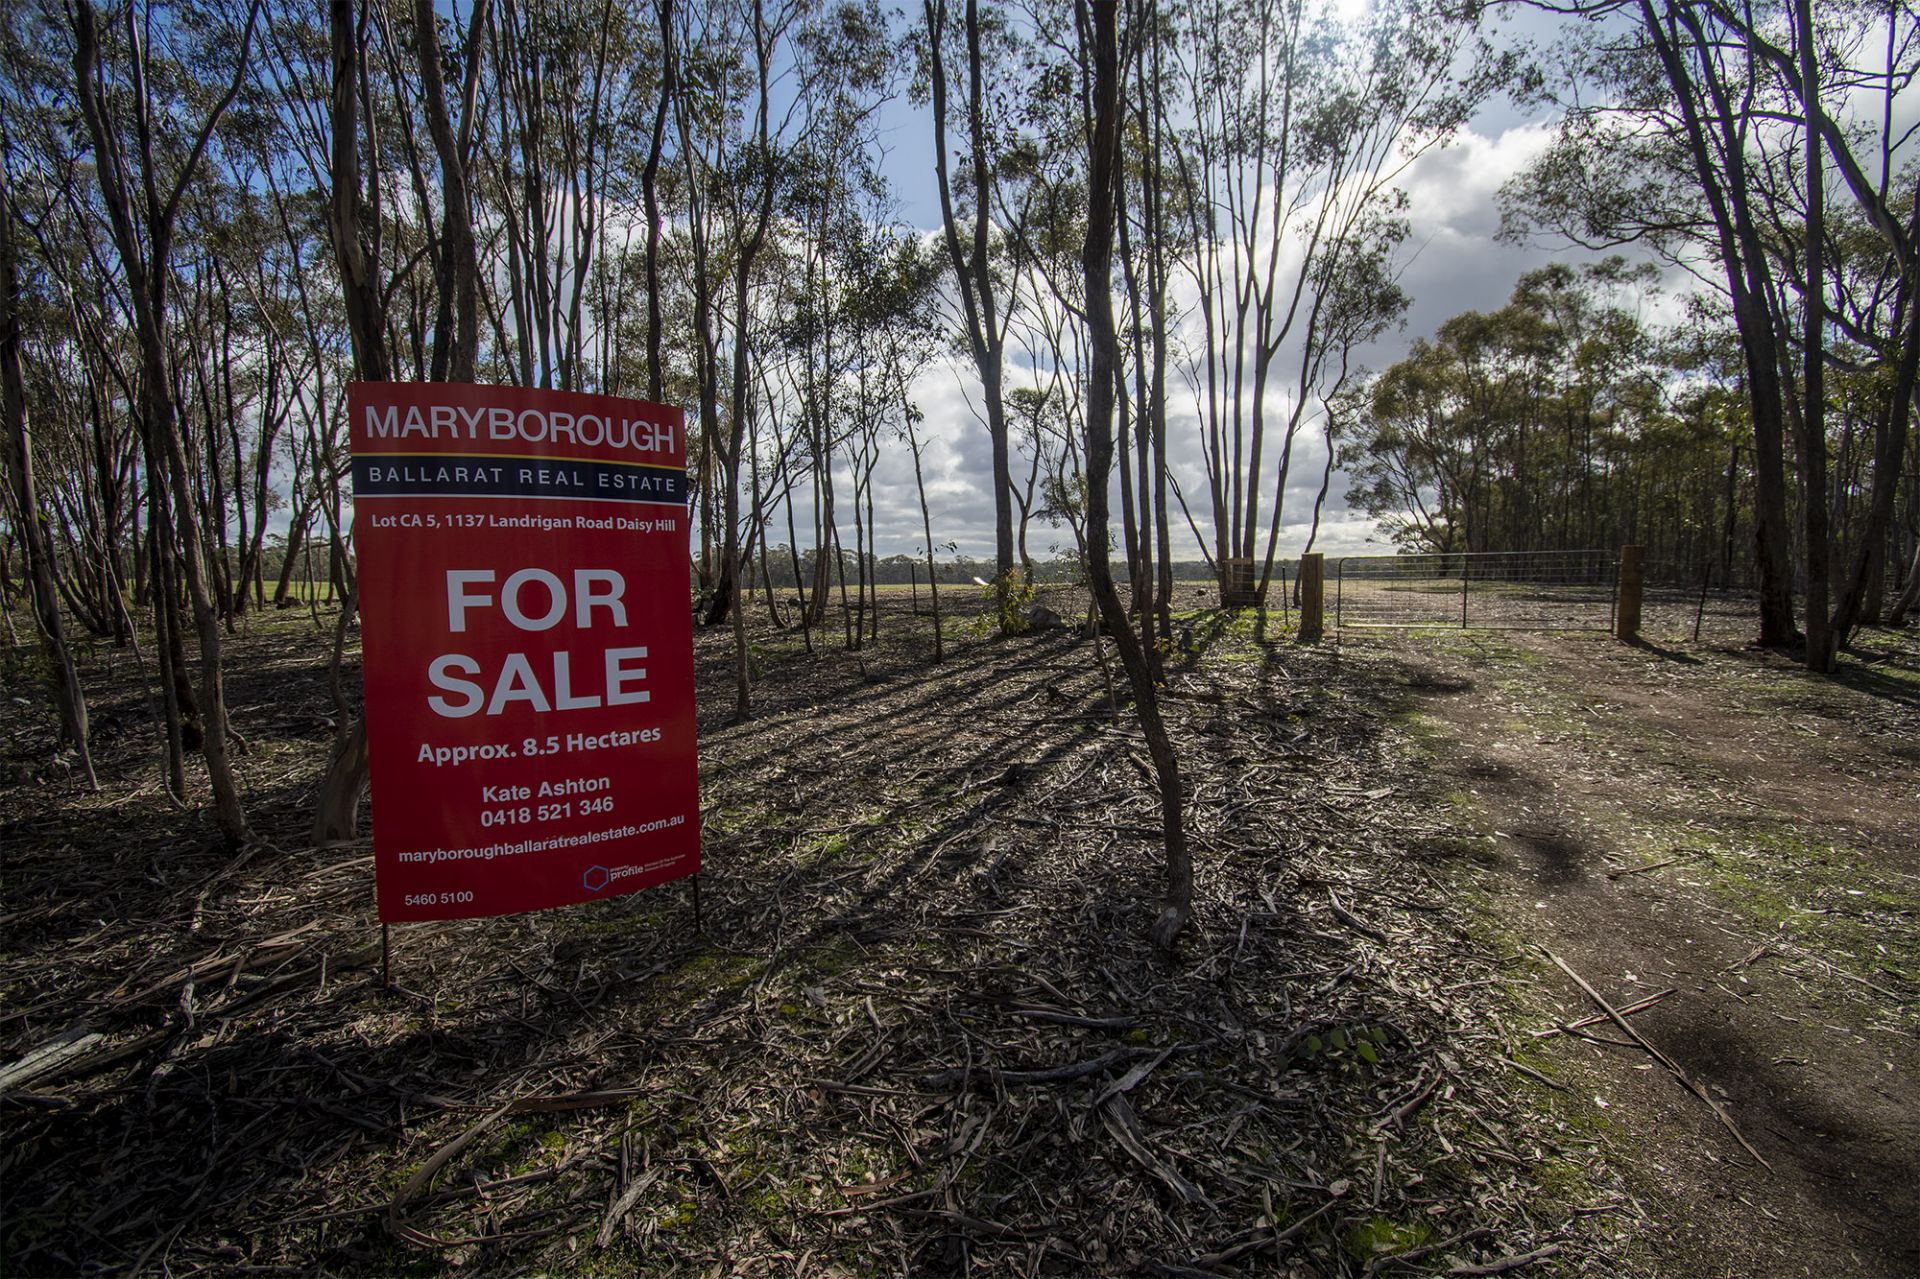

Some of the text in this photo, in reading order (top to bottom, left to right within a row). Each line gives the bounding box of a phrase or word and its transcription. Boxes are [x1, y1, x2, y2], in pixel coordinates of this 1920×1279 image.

[365, 405, 675, 454] MARYBOROUGH
[369, 467, 675, 492] BALLARAT REAL ESTATE
[372, 514, 676, 533] Lot CA 5, 1137 Landrigan Road Daisy Hill
[446, 568, 629, 632] FOR
[427, 646, 651, 718] SALE
[417, 727, 662, 767] Approx. 8.5 Hectares
[482, 776, 610, 803] Kate Ashton
[481, 796, 614, 827] 0418 521 346
[399, 814, 685, 864] maryboroughballaratrealestate.com.au
[610, 865, 644, 882] profile
[404, 891, 474, 906] 5460 5100
